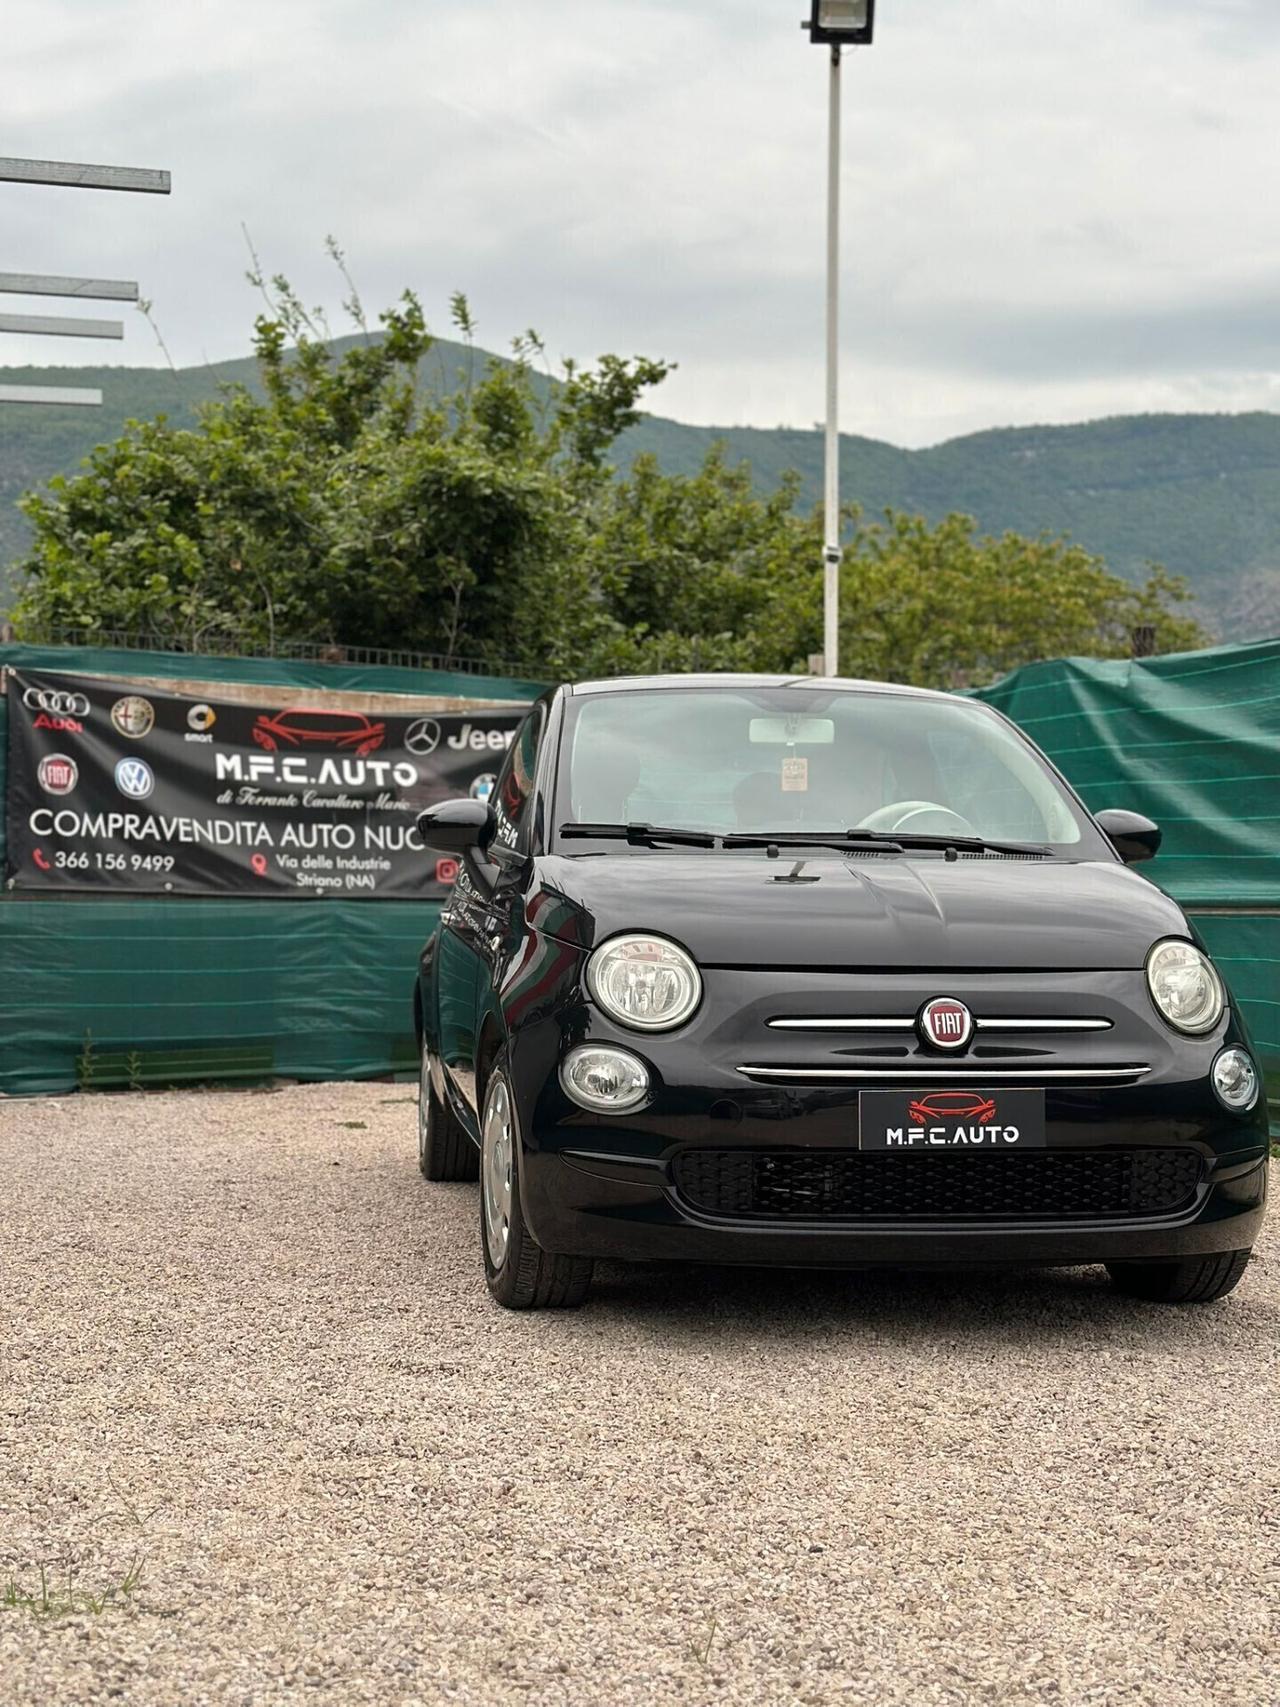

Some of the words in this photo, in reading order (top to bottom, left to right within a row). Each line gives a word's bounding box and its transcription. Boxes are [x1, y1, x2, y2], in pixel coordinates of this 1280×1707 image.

[33, 714, 83, 733] Audi
[184, 732, 213, 744] smart
[46, 766, 71, 784] FIAT
[215, 753, 418, 787] M.F.C.AUTO
[29, 809, 274, 846] COMPRAVENDITA
[280, 824, 356, 848] AUTO
[364, 827, 425, 851] NUO
[54, 851, 89, 868] 366
[96, 852, 126, 869] 156
[131, 854, 175, 872] 9499
[276, 855, 299, 869] Via
[302, 854, 333, 869] delle
[336, 856, 391, 871] Industrie
[296, 873, 342, 888] Striano
[345, 873, 375, 890] (NA)
[934, 1012, 961, 1034] FIAT
[886, 1126, 1020, 1146] M.F.C.AUTO
